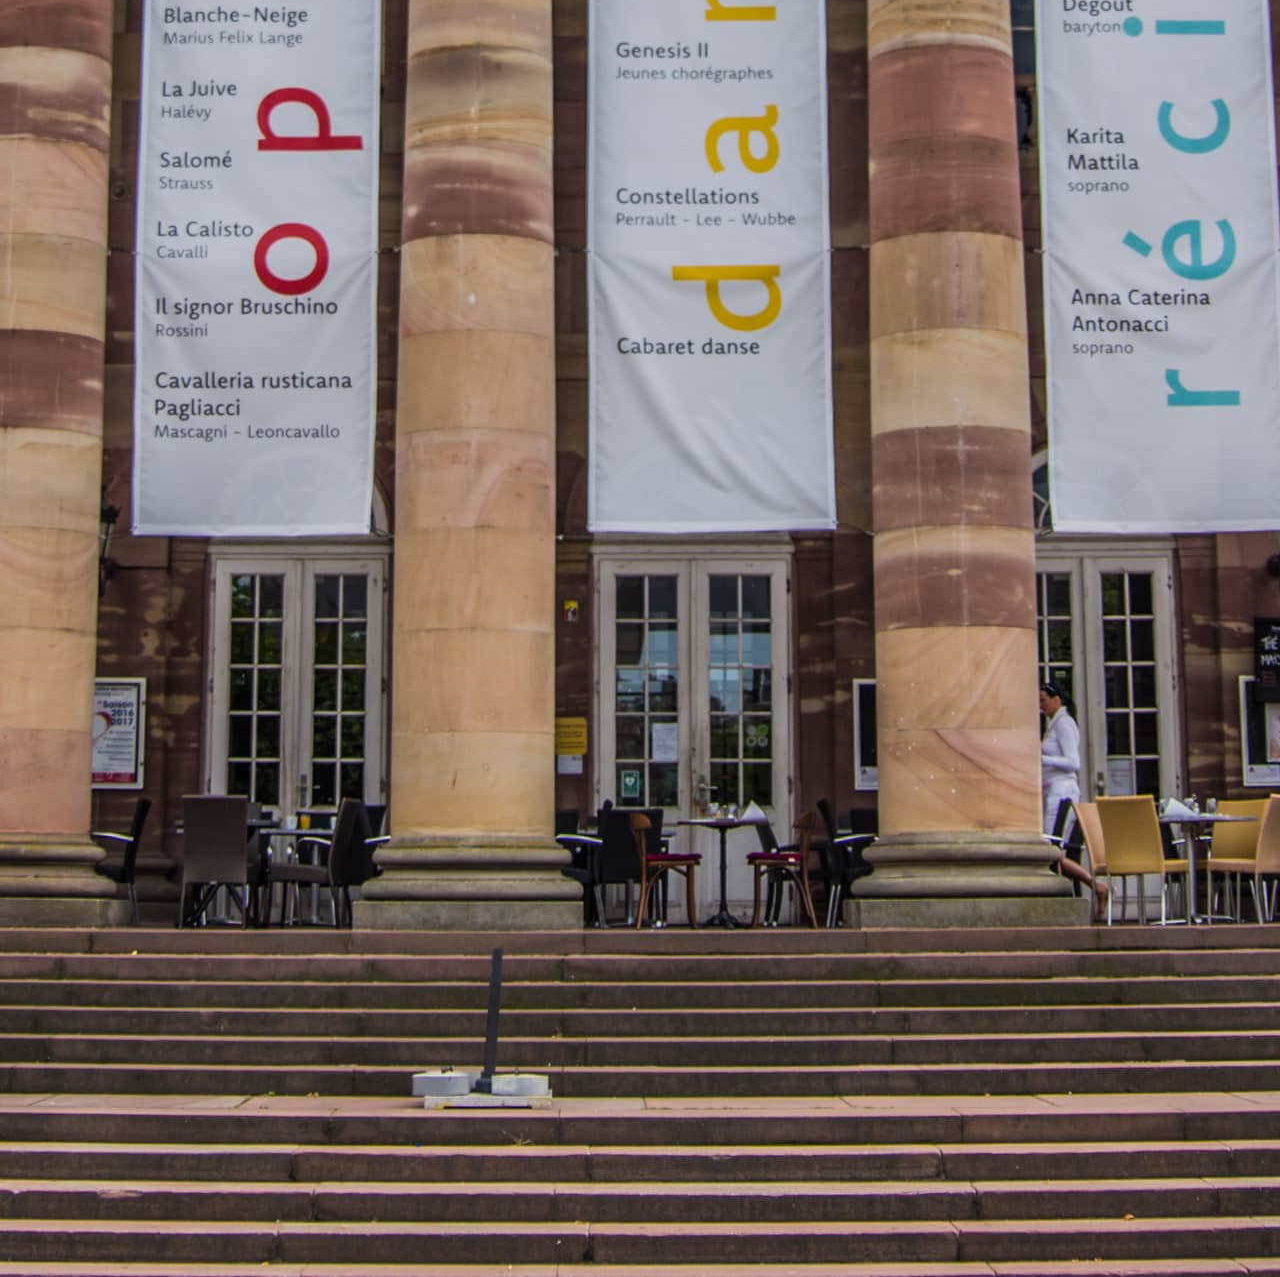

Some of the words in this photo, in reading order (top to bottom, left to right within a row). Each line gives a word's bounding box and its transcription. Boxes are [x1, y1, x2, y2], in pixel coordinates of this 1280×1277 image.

[1063, 20, 1121, 36] baryton
[163, 30, 214, 45] Marius
[219, 30, 253, 45] Felix
[260, 30, 303, 48] Lange
[616, 42, 692, 59] Genesis
[698, 43, 709, 58] II
[616, 67, 667, 80] Jeunes
[671, 66, 773, 83] chorégraphes
[161, 81, 183, 98] La
[188, 80, 237, 98] Juive
[161, 105, 211, 122] Halévy
[1066, 128, 1124, 144] Karita
[160, 150, 232, 168] Salomé
[1068, 154, 1139, 171] Mattila
[160, 176, 213, 190] Strauss
[1068, 180, 1129, 195] soprano
[616, 187, 759, 205] Constellations
[616, 213, 676, 226] Perrault
[696, 213, 721, 226] Lee
[742, 212, 796, 226] Wubbe
[157, 221, 179, 238] La
[186, 221, 253, 238] Calisto
[156, 245, 208, 259] Cavalli
[1071, 289, 1121, 306] Anna
[1128, 289, 1211, 306] Caterina
[156, 298, 170, 315] Il
[173, 298, 233, 319] signor
[240, 298, 338, 315] Bruschino
[155, 323, 208, 338] Rossini
[1072, 315, 1169, 332] Antonacci
[617, 338, 695, 355] Cabaret
[701, 337, 760, 355] danse
[1072, 341, 1133, 357] soprano
[155, 371, 254, 389] Cavalleria
[261, 372, 352, 389] rusticana
[154, 399, 240, 421] Pagliacci
[154, 425, 228, 443] Mascagni
[247, 424, 340, 440] Leoncavallo
